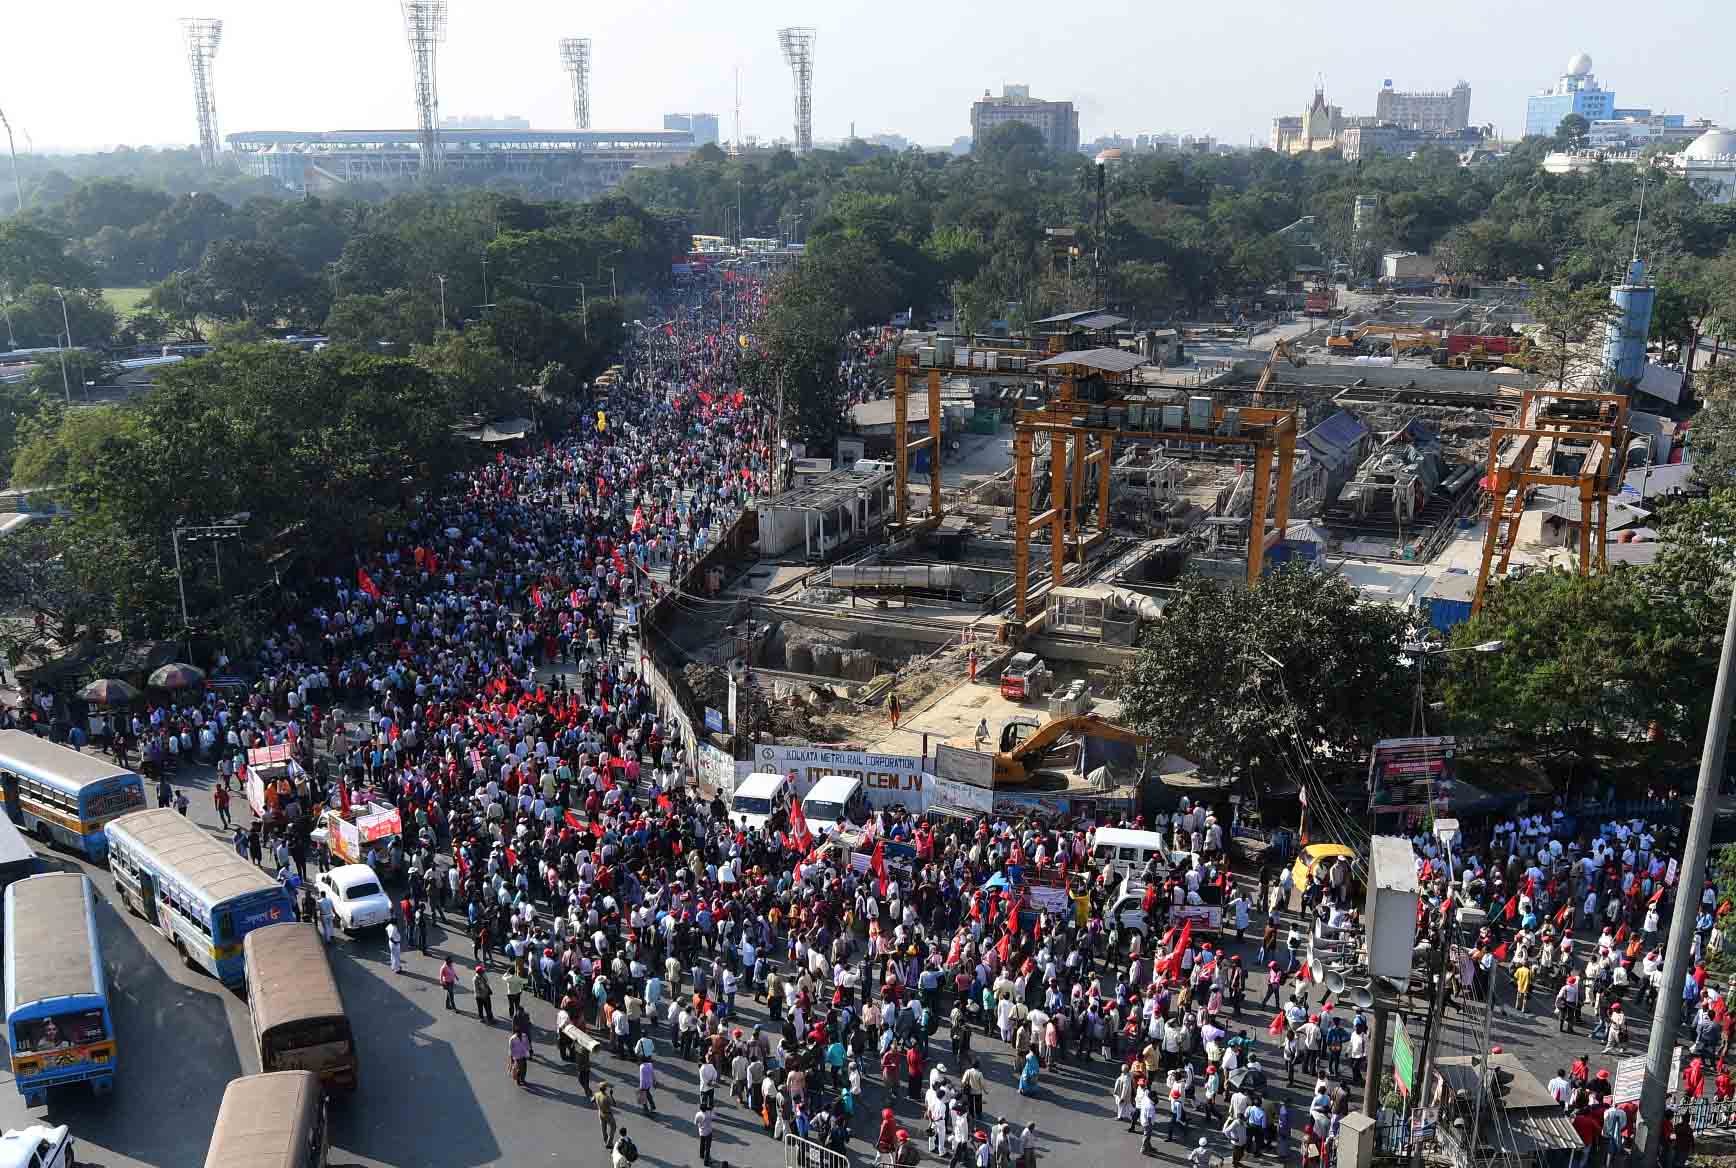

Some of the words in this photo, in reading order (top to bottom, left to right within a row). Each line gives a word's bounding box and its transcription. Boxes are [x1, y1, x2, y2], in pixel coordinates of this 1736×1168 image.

[786, 749, 818, 761] KOLKATA
[821, 752, 845, 763] METRO
[847, 754, 863, 766] RAIL
[866, 755, 915, 769] CORPORATION
[866, 771, 899, 789] CEM
